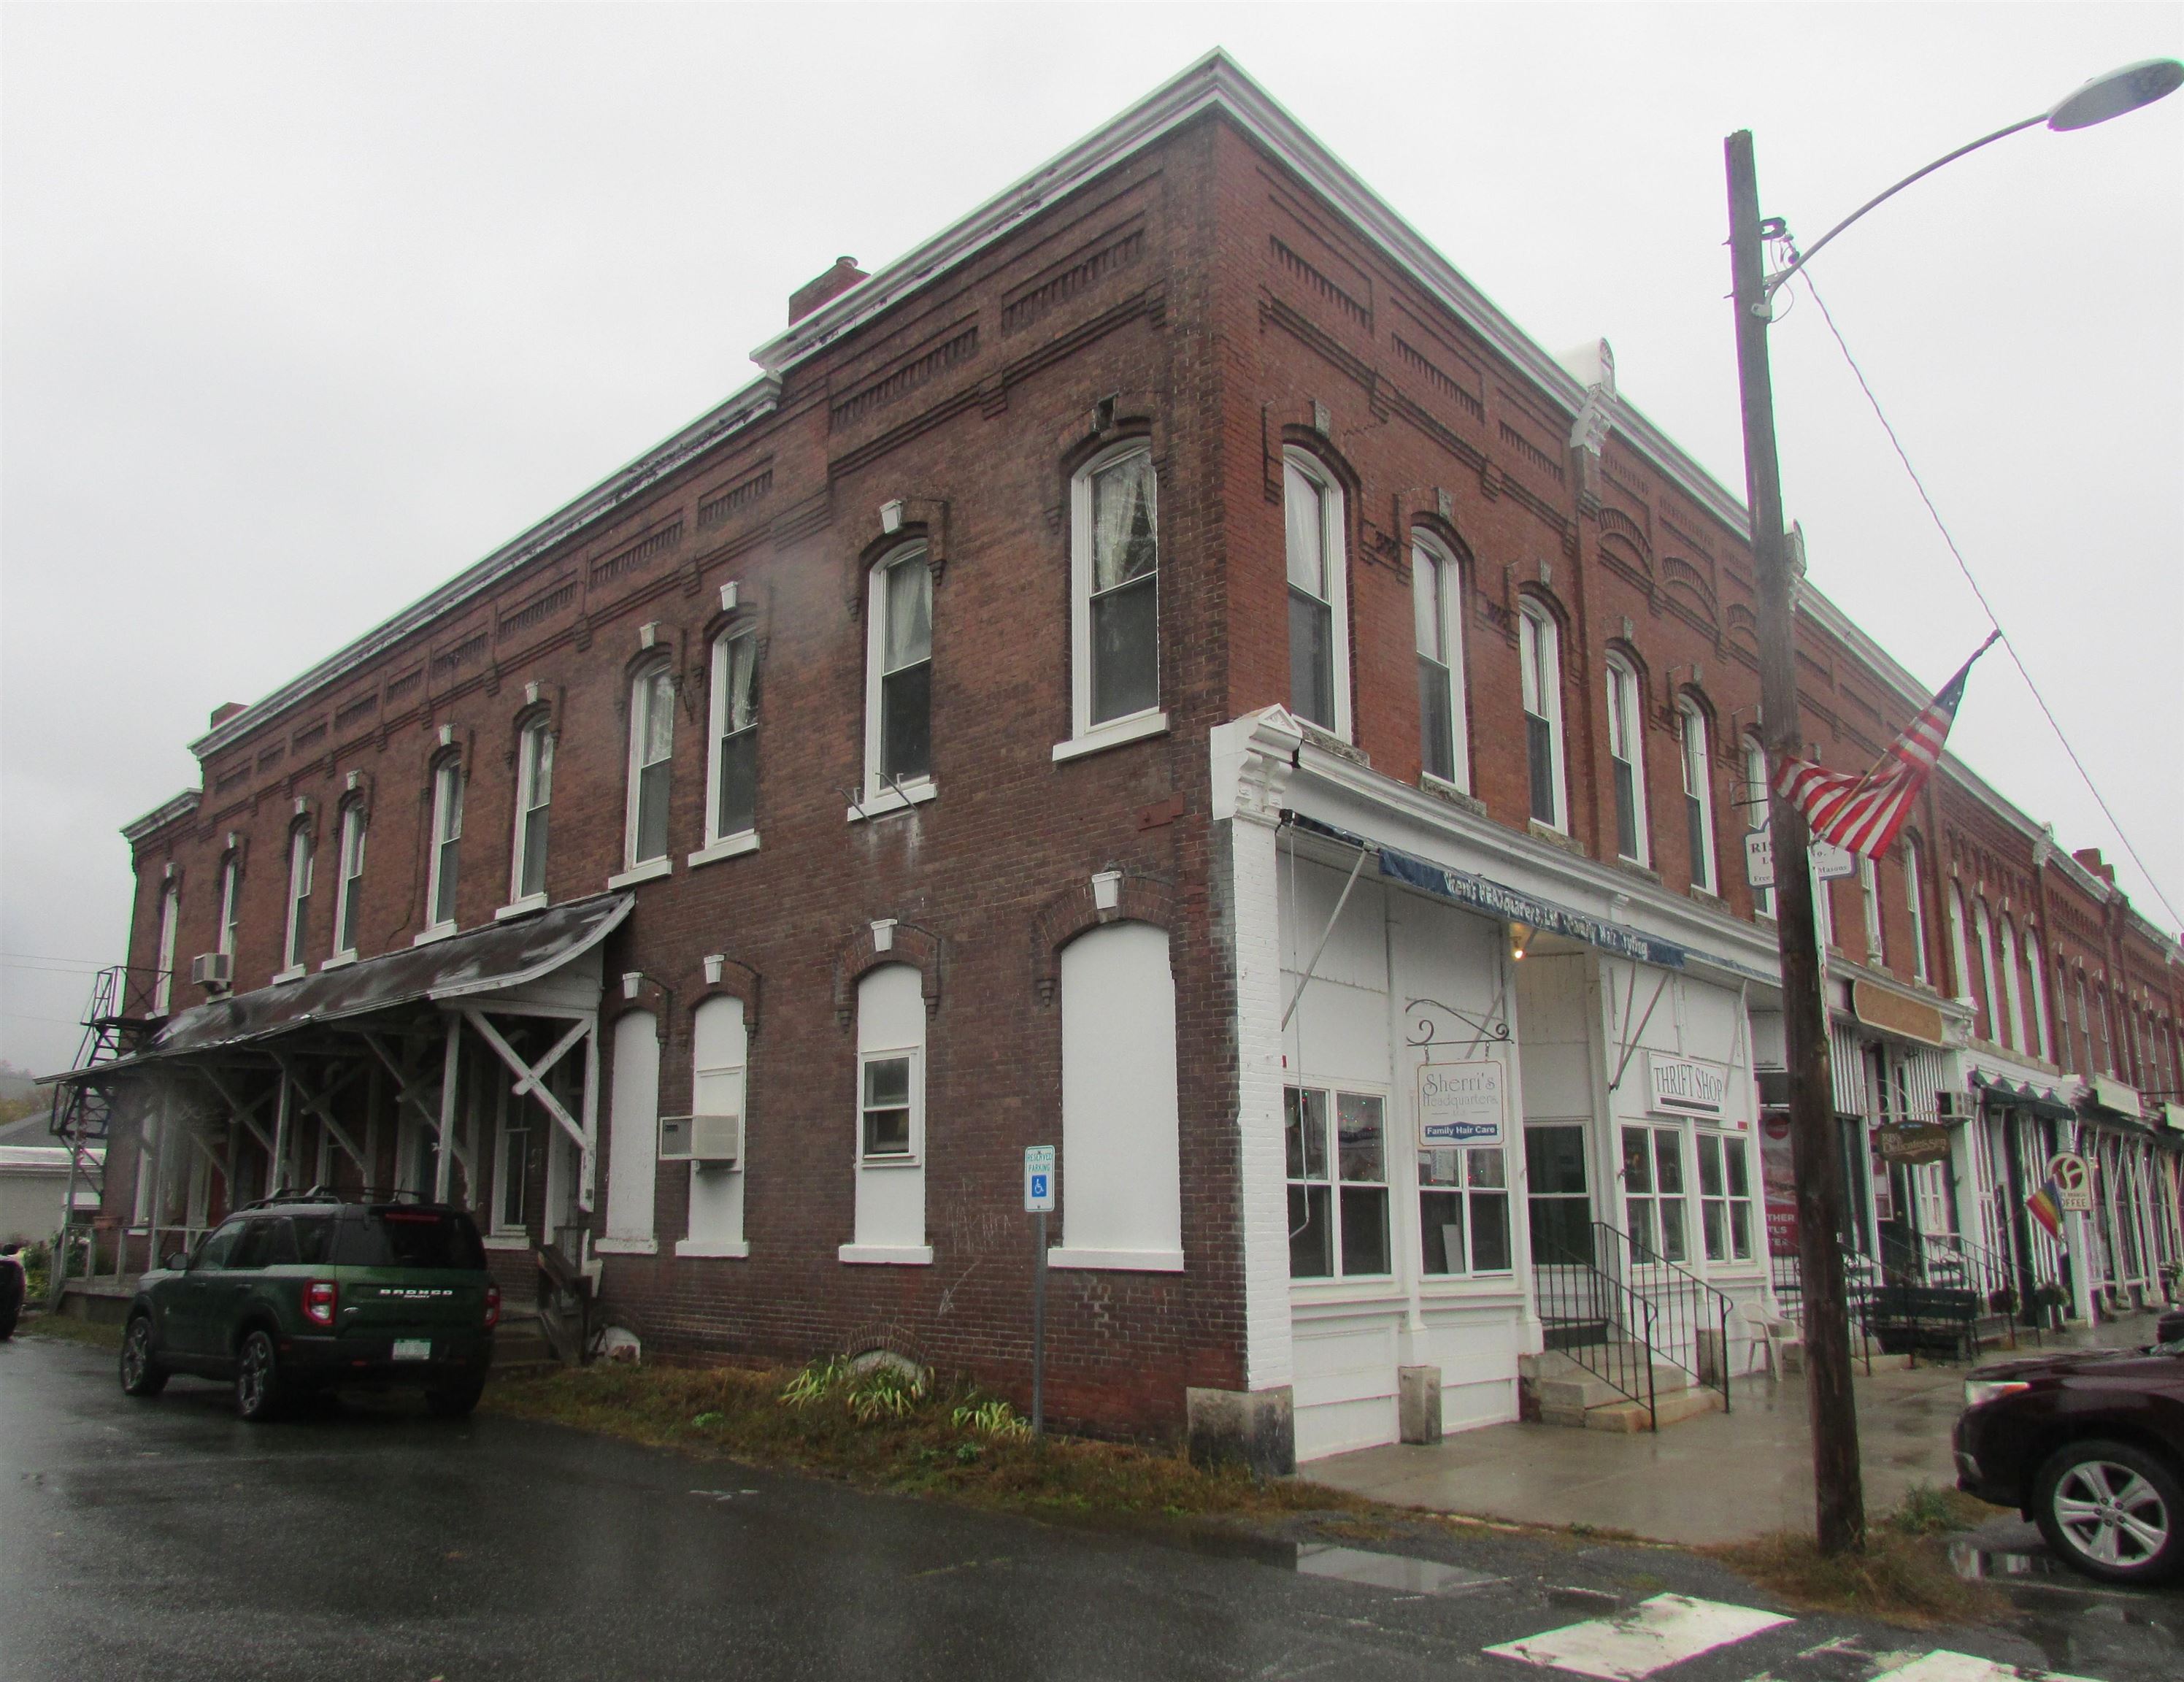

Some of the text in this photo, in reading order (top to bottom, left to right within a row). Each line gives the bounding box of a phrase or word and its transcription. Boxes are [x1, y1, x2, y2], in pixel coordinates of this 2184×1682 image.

[1423, 1072, 1496, 1096] Sherri's
[1654, 1064, 1723, 1102] THRIFT SHOP
[1426, 1126, 1496, 1136] Family Hair Care
[1027, 1153, 1052, 1161] RESERVED
[1028, 1164, 1051, 1172] PARKING
[2062, 1198, 2085, 1207] OFFEE
